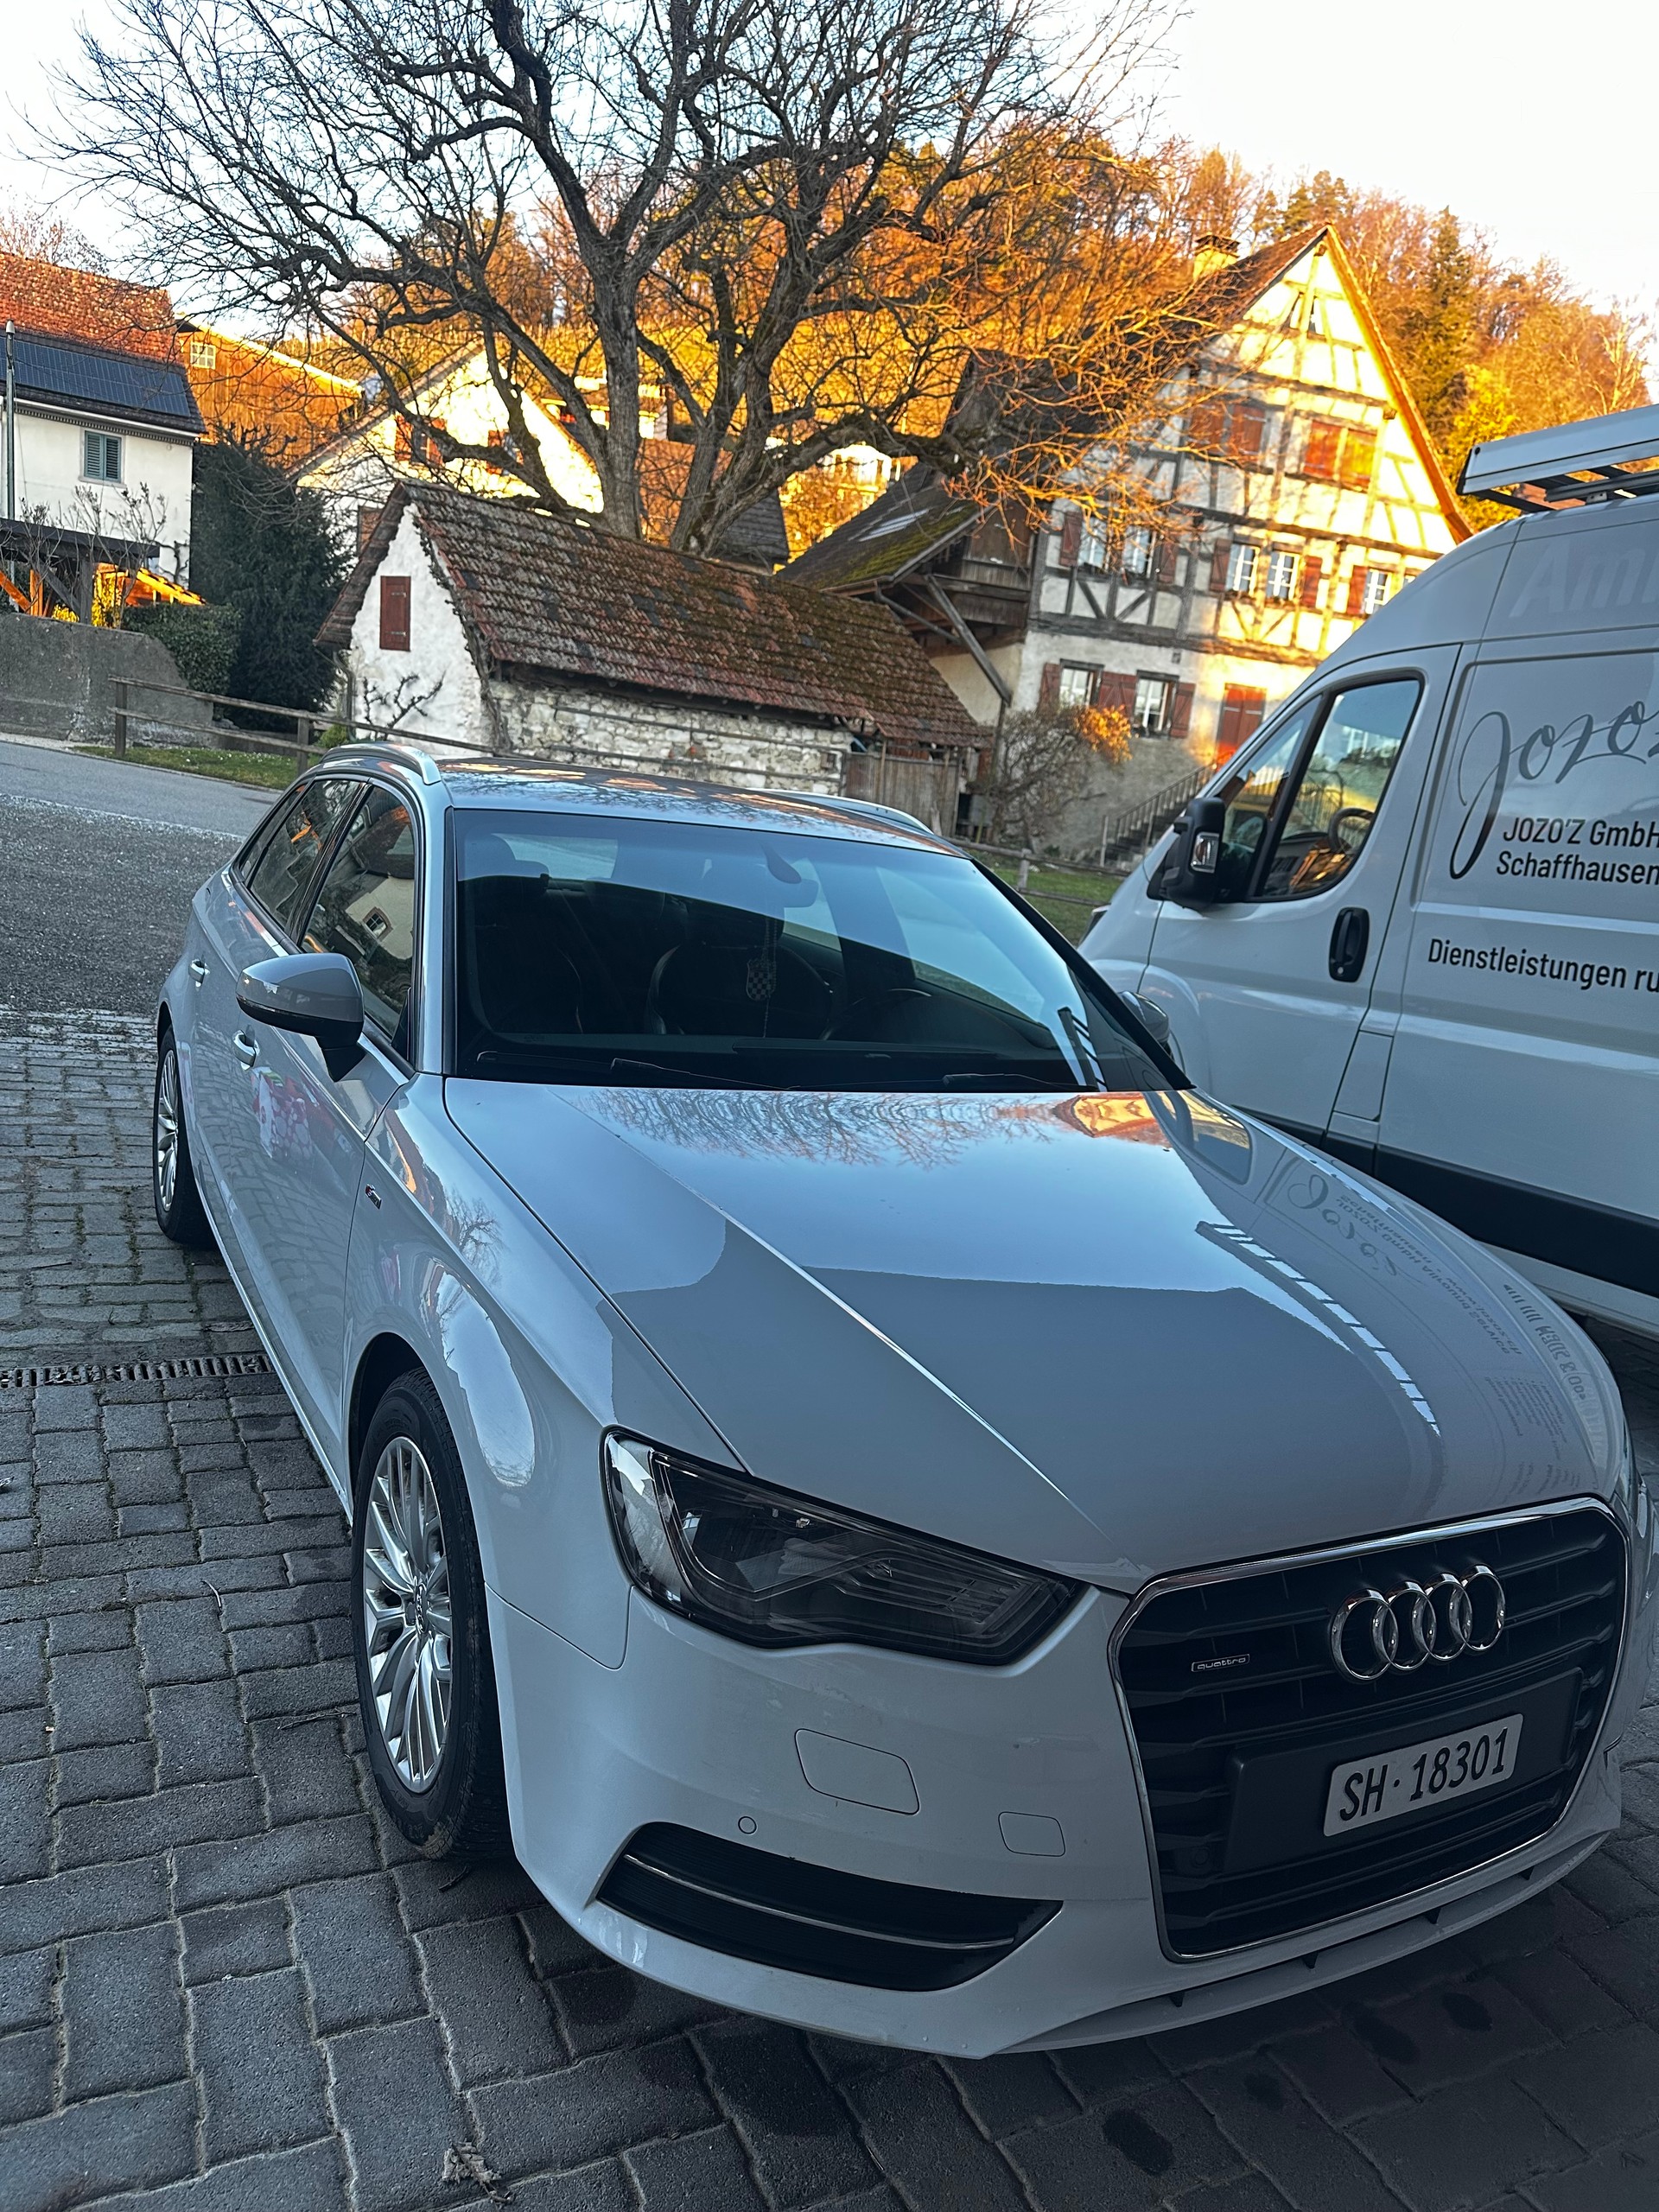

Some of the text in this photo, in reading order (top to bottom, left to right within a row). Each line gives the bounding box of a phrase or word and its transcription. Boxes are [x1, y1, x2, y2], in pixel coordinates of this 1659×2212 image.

[1503, 817, 1586, 844] JOZO'Z
[1497, 850, 1659, 886] Schaffhausen
[1427, 938, 1627, 990] Dienstleistungen
[1197, 1657, 1246, 1670] quattro
